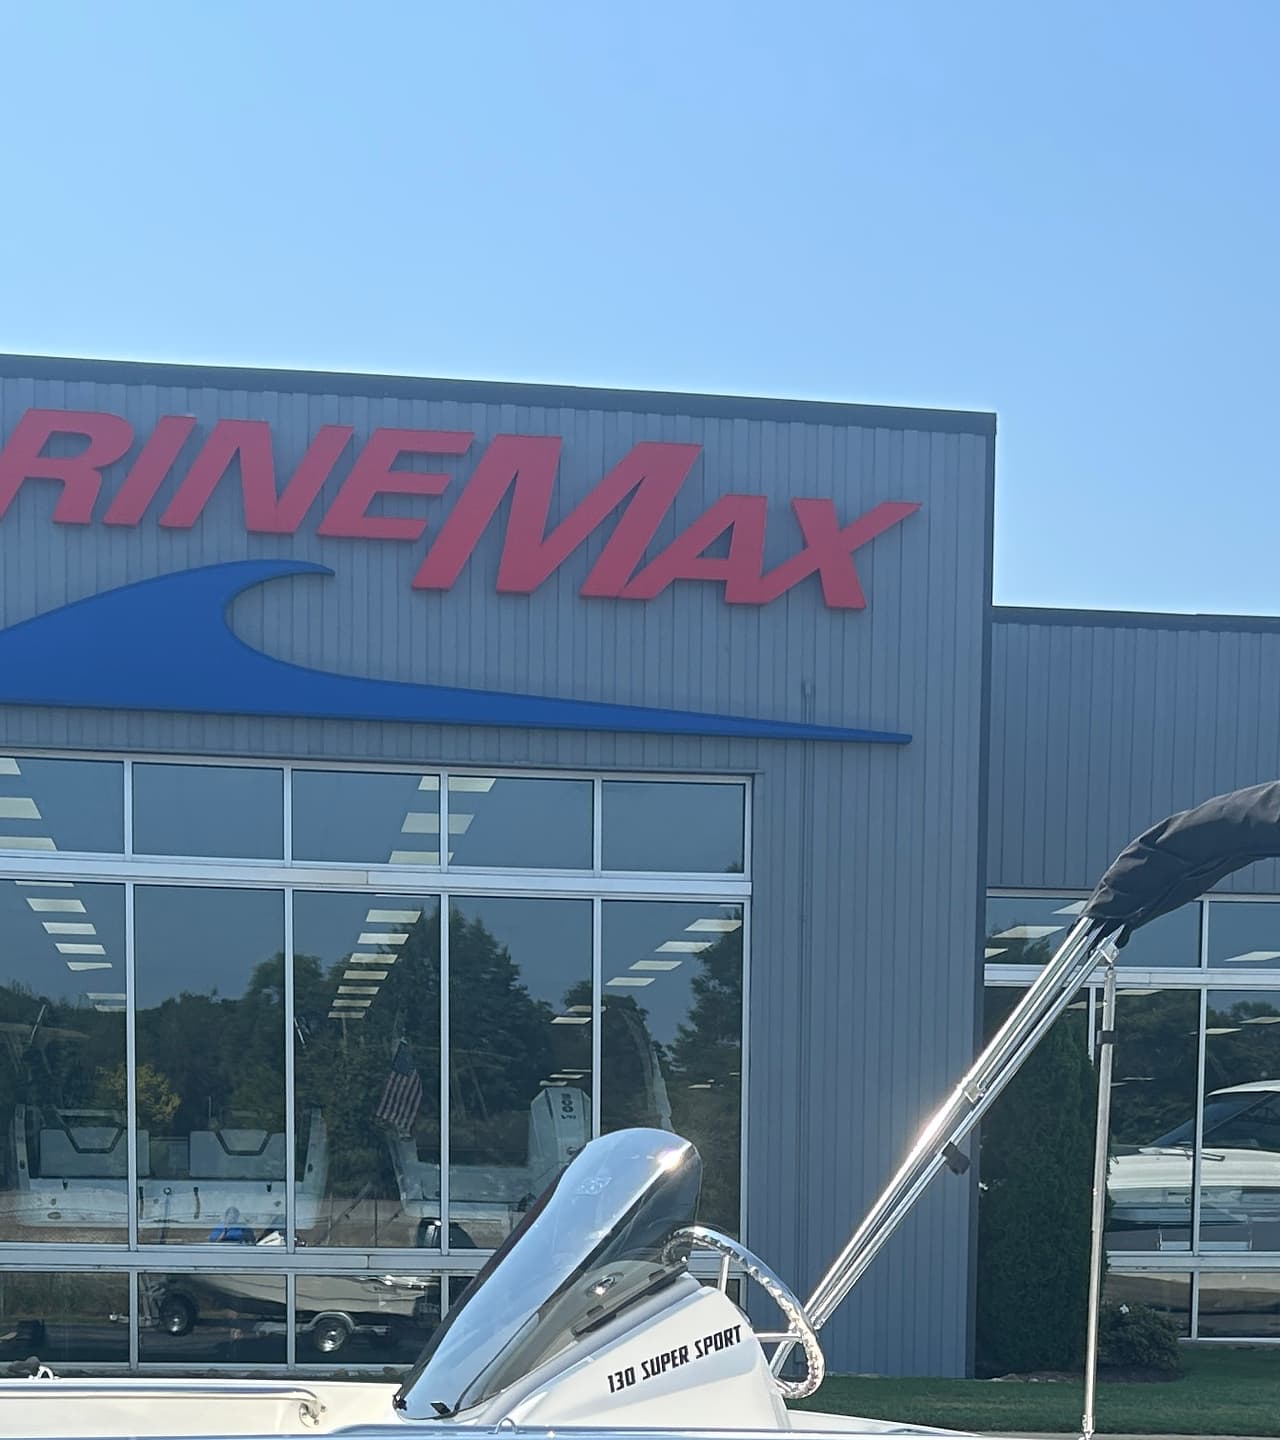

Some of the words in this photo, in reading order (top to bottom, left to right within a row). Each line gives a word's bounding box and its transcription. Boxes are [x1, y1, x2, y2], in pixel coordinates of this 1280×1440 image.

[607, 1366, 636, 1393] 130
[640, 1345, 690, 1380] SUPER
[694, 1324, 741, 1359] SPORT
